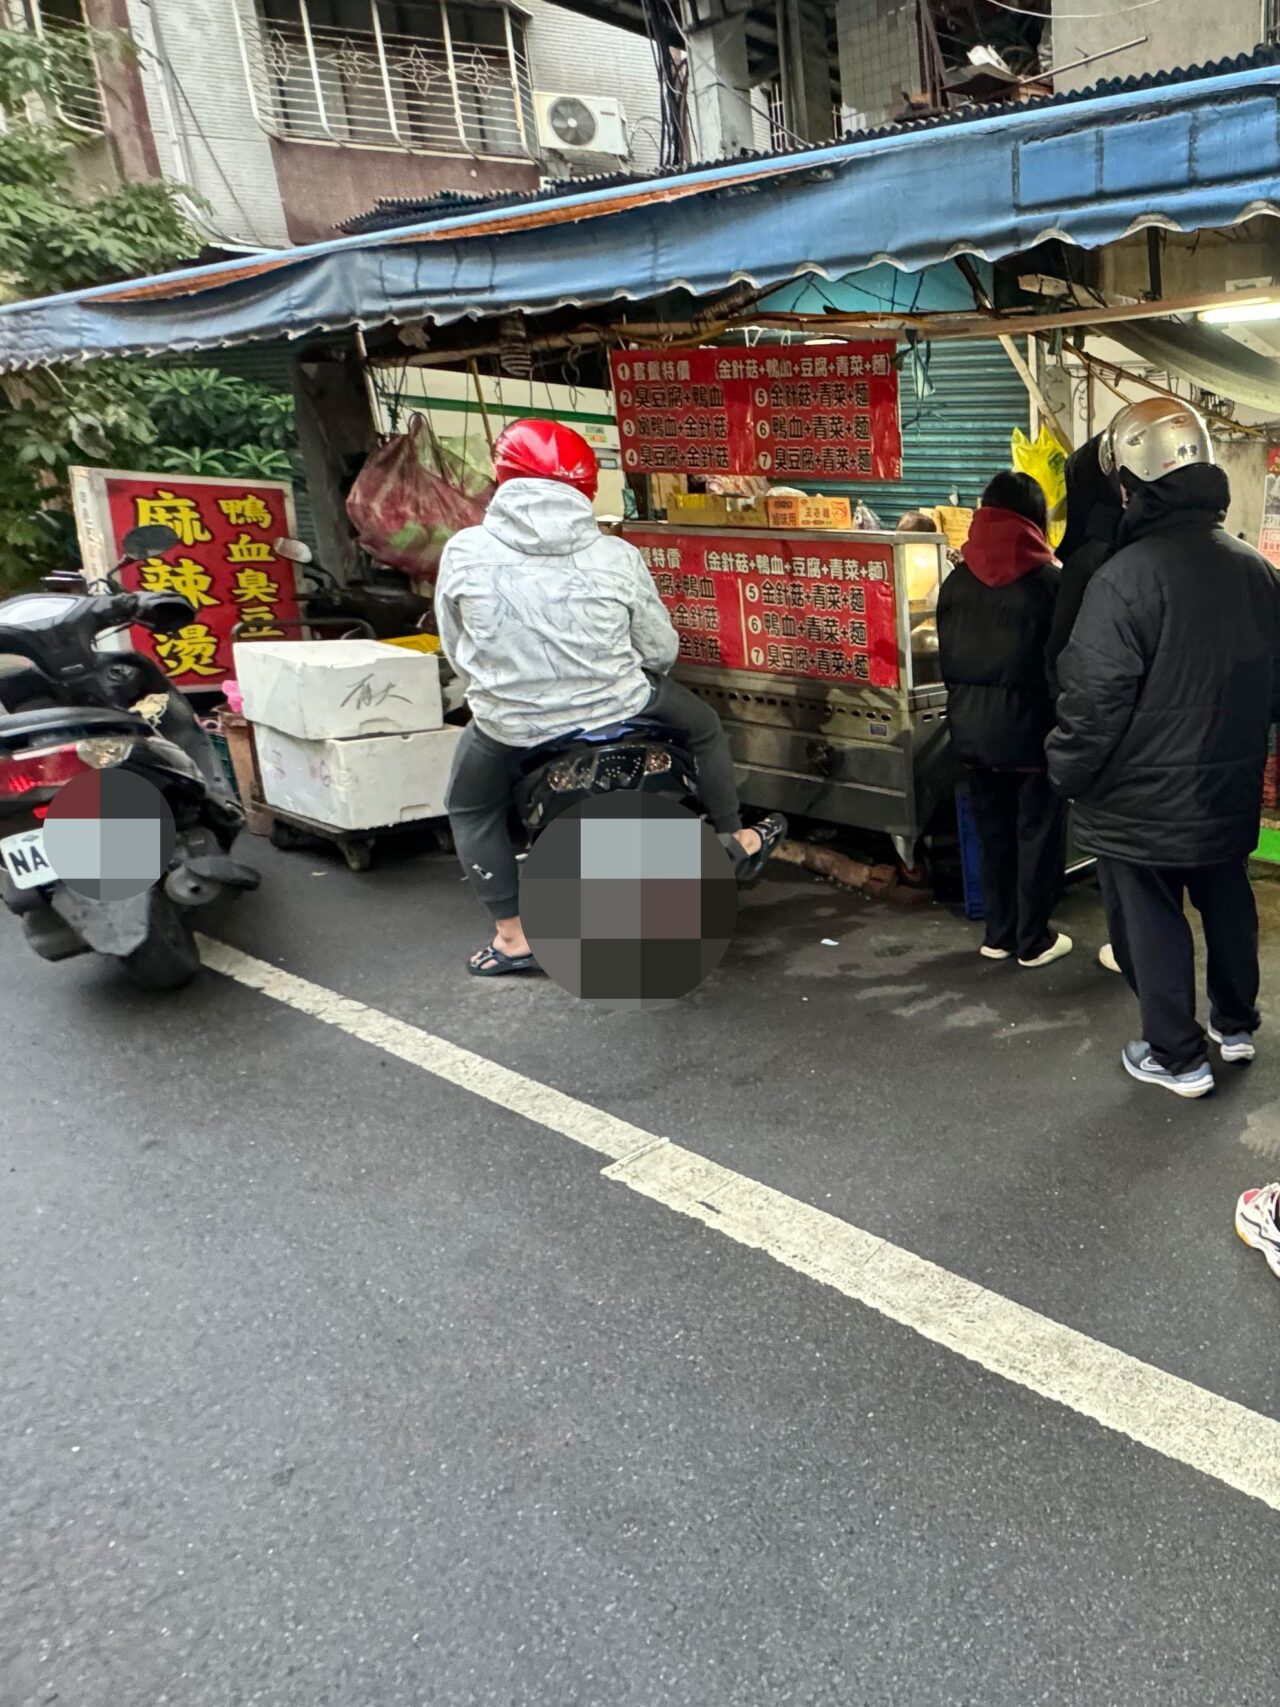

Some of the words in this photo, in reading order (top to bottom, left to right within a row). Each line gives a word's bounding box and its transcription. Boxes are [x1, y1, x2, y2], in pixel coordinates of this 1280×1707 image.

[634, 384, 725, 409] 臭豆腐+鴨血
[770, 381, 869, 409] 金針菇+青菜+麵
[771, 414, 870, 440] 鴨血+青菜+麵
[640, 444, 729, 468] 臭豆腐+金針菇
[774, 446, 872, 472] 臭豆腐+青菜+麵
[135, 490, 228, 677] 麻辣燙
[761, 578, 866, 614] 金針菇+青菜+麵
[763, 610, 868, 648] 鴨血+青菜+麵
[767, 643, 870, 680] 臭豆腐+青菜+麵
